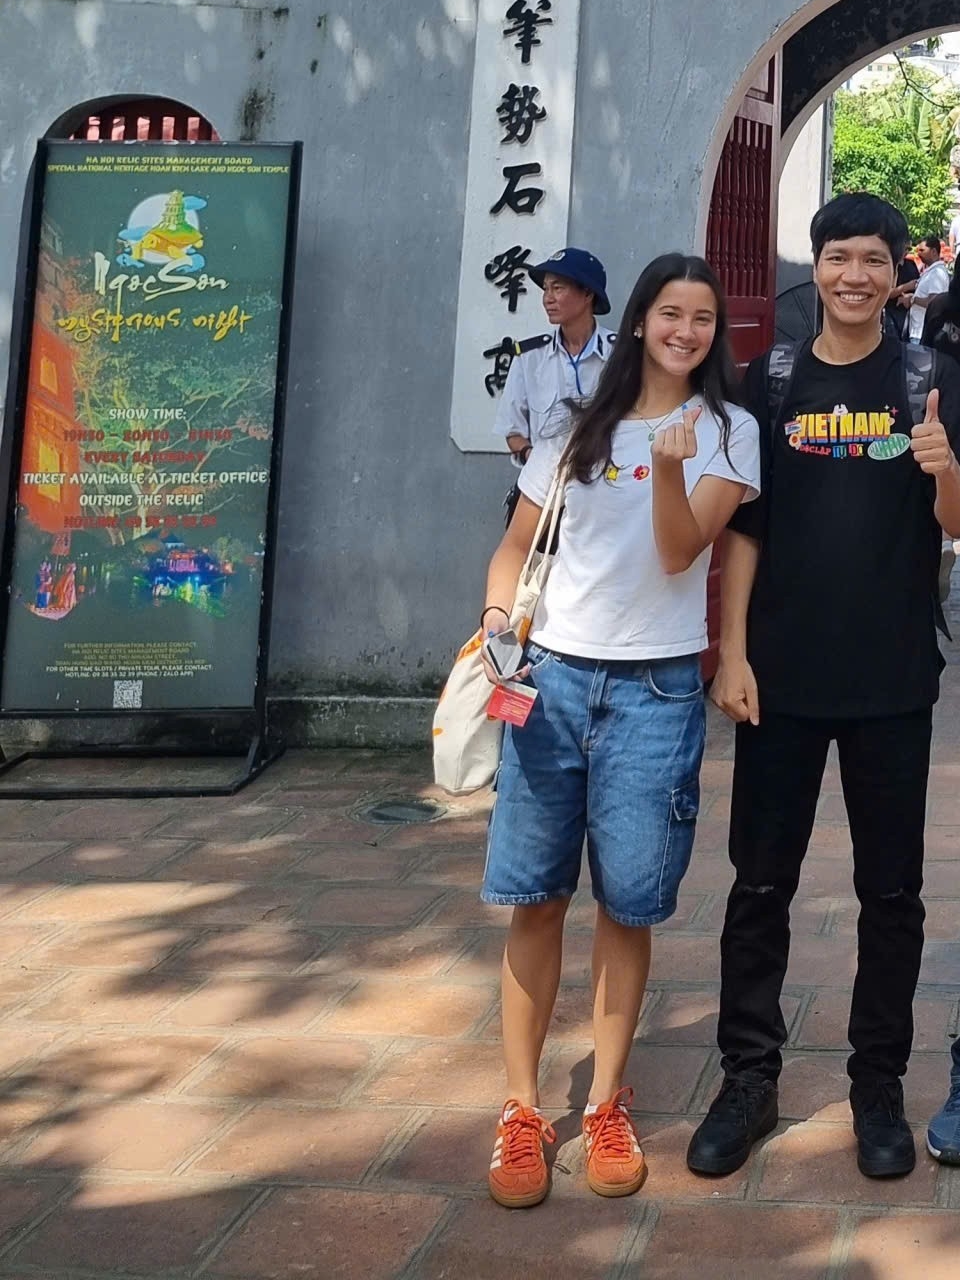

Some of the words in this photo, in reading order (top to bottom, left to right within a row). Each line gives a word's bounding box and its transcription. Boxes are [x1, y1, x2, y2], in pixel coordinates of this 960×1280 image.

[166, 157, 222, 165] MANAGEMENT
[224, 157, 253, 165] BOARD
[109, 408, 149, 420] SHOW
[151, 408, 187, 420] TIME:
[797, 412, 891, 441] VIETNAM
[24, 472, 66, 484] TICKET
[69, 472, 144, 484] AVAILABLE
[148, 472, 168, 484] AT
[171, 472, 216, 484] TICKET
[219, 472, 267, 484] OFFICE
[79, 494, 132, 506] OUTSIDE
[136, 494, 162, 506] THE
[166, 494, 204, 506] RELIC
